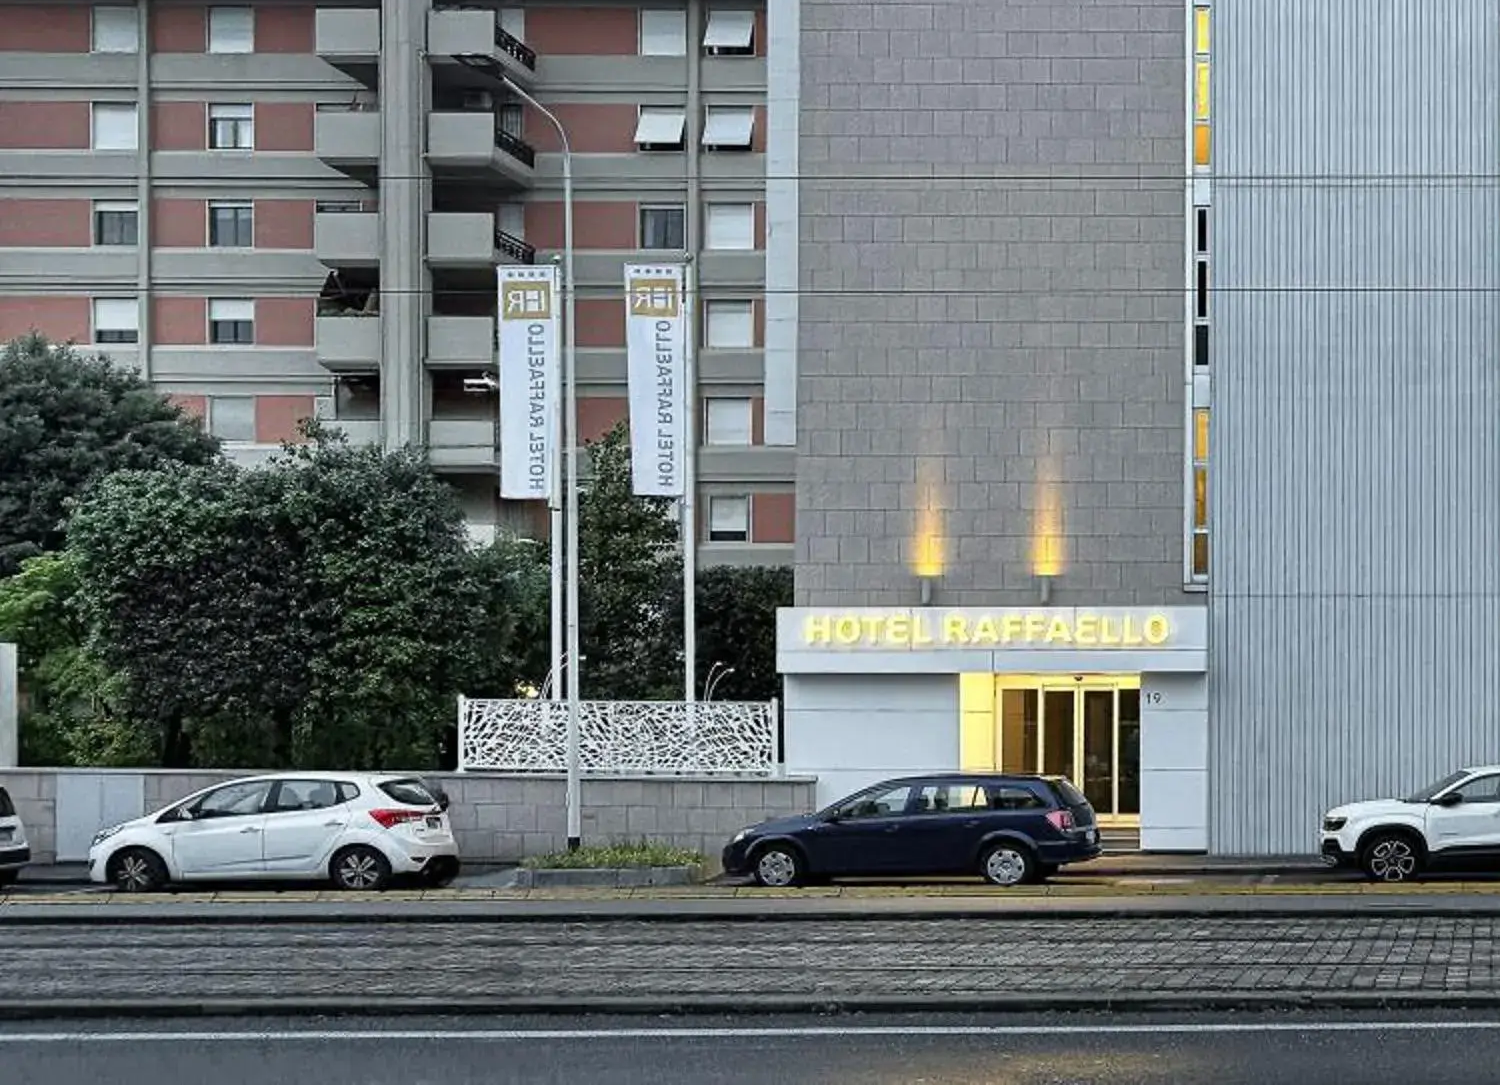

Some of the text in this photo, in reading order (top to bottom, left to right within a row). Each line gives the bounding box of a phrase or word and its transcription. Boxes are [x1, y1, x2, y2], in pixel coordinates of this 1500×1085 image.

[804, 612, 1172, 645] HOTEL RAFFAELLO
[1146, 692, 1161, 704] 19
